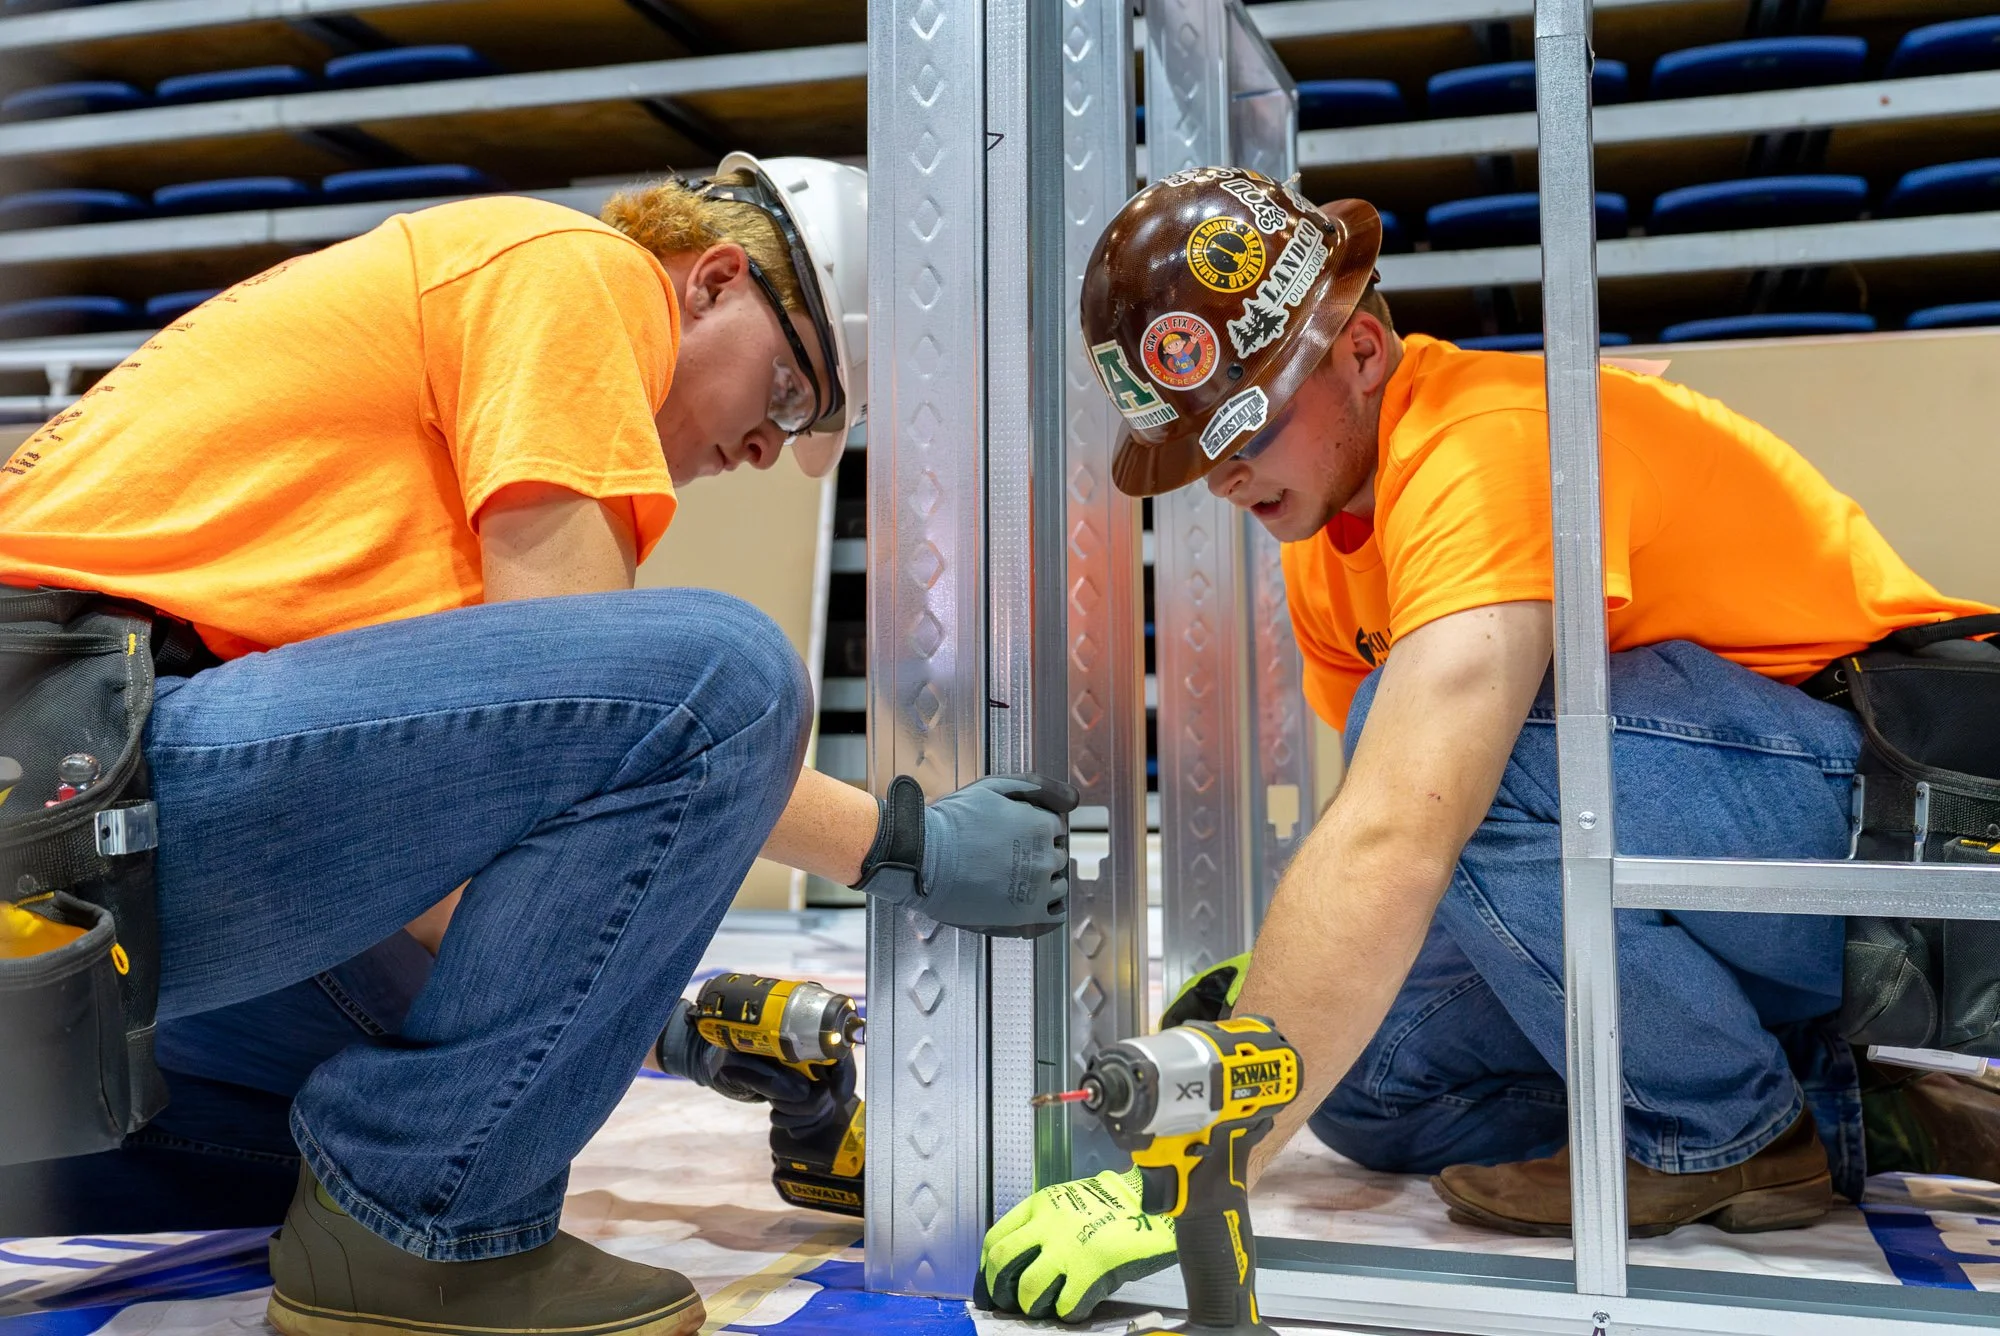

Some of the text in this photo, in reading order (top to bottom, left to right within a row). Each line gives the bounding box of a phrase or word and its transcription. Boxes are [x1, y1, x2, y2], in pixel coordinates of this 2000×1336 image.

[1192, 220, 1237, 284] CERTIFIED SHOVEL
[1229, 228, 1262, 289] OPERATOR
[1261, 221, 1317, 304] LANDCO
[1289, 245, 1327, 303] OUTDOORS
[1145, 318, 1206, 352] CAN WE FIX IT?
[1149, 363, 1161, 375] NO
[1190, 343, 1215, 381] SCREWED
[1096, 346, 1158, 412] A
[1176, 1081, 1205, 1102] XR
